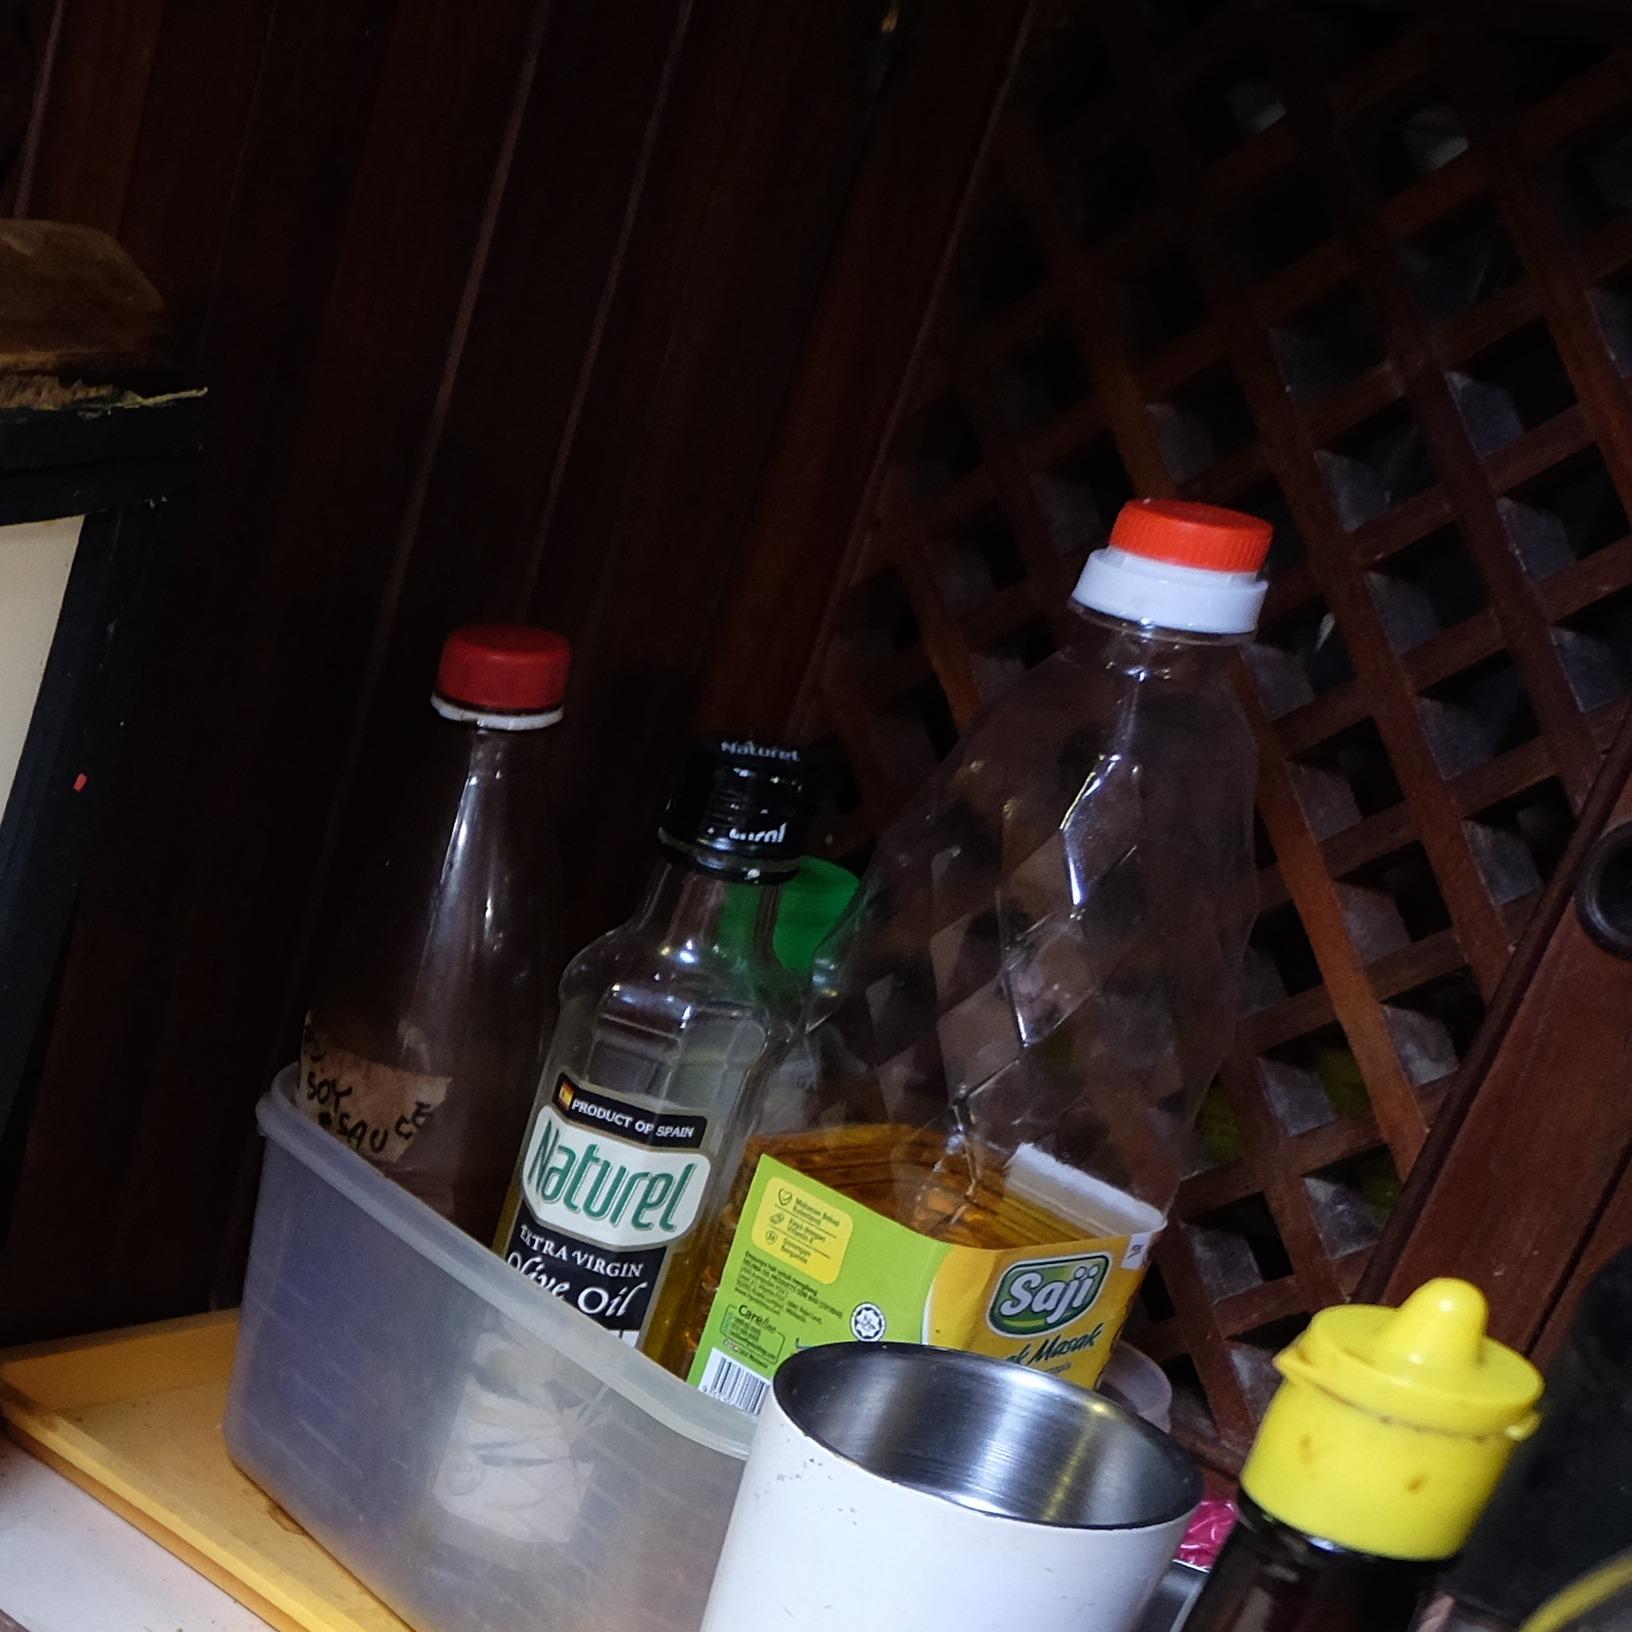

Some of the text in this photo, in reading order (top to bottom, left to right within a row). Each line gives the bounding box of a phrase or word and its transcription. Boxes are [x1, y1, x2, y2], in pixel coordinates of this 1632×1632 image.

[306, 1071, 353, 1113] SOY
[337, 1100, 432, 1153] SAUCE
[572, 1099, 694, 1139] PRODUCT OF SPAIN
[527, 1118, 697, 1232] Naturel
[520, 1224, 644, 1277] EXTRA VIRGIN
[578, 1281, 647, 1317] Oil
[999, 1264, 1100, 1324] Saji
[1028, 1322, 1105, 1364] Masak
